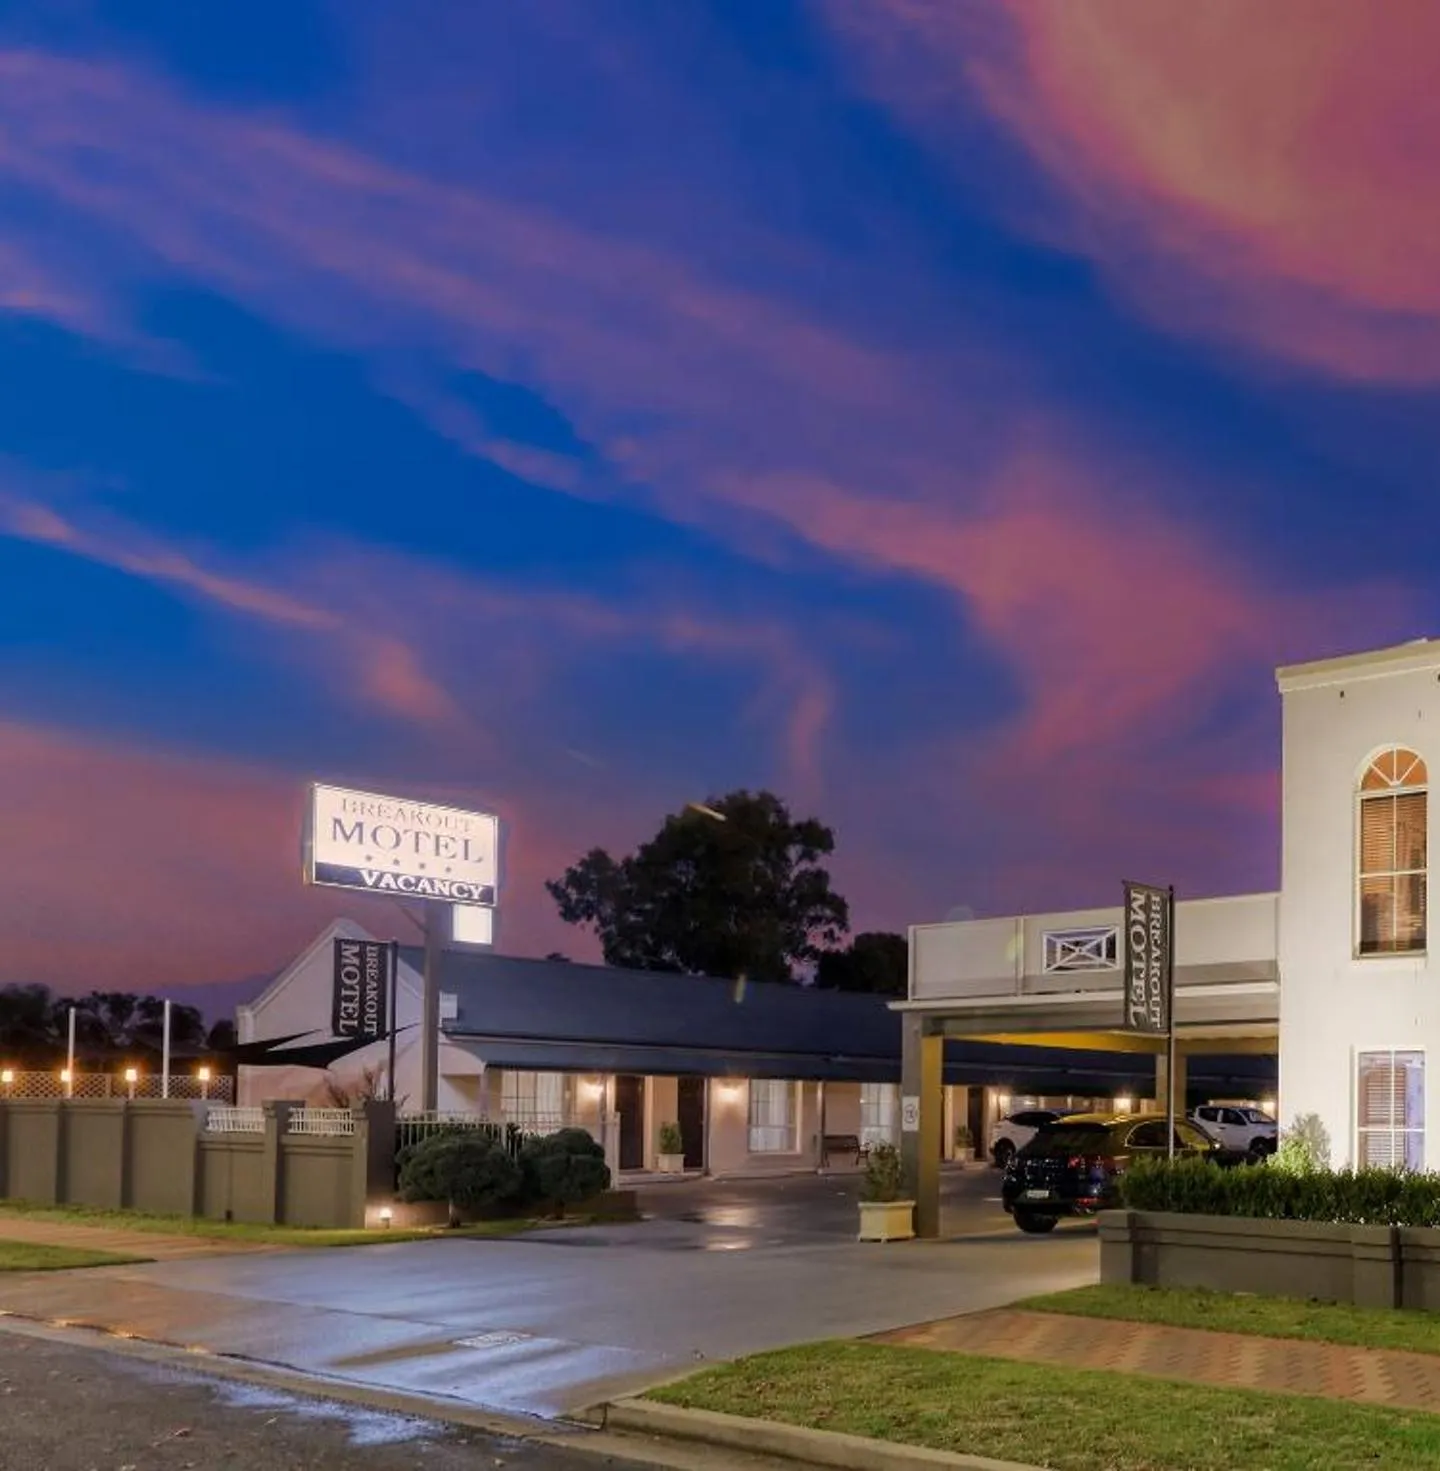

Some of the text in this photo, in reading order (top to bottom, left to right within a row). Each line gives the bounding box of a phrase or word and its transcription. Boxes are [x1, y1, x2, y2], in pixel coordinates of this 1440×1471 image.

[331, 817, 484, 863] MOTEL
[342, 797, 474, 833] BREAKOUT
[359, 868, 485, 900] VACANCY
[339, 942, 360, 1034] MOTEL
[364, 945, 379, 1036] BREAKOUT
[1130, 888, 1147, 1028] MOTEL
[1150, 895, 1162, 1028] BREAKOUT
